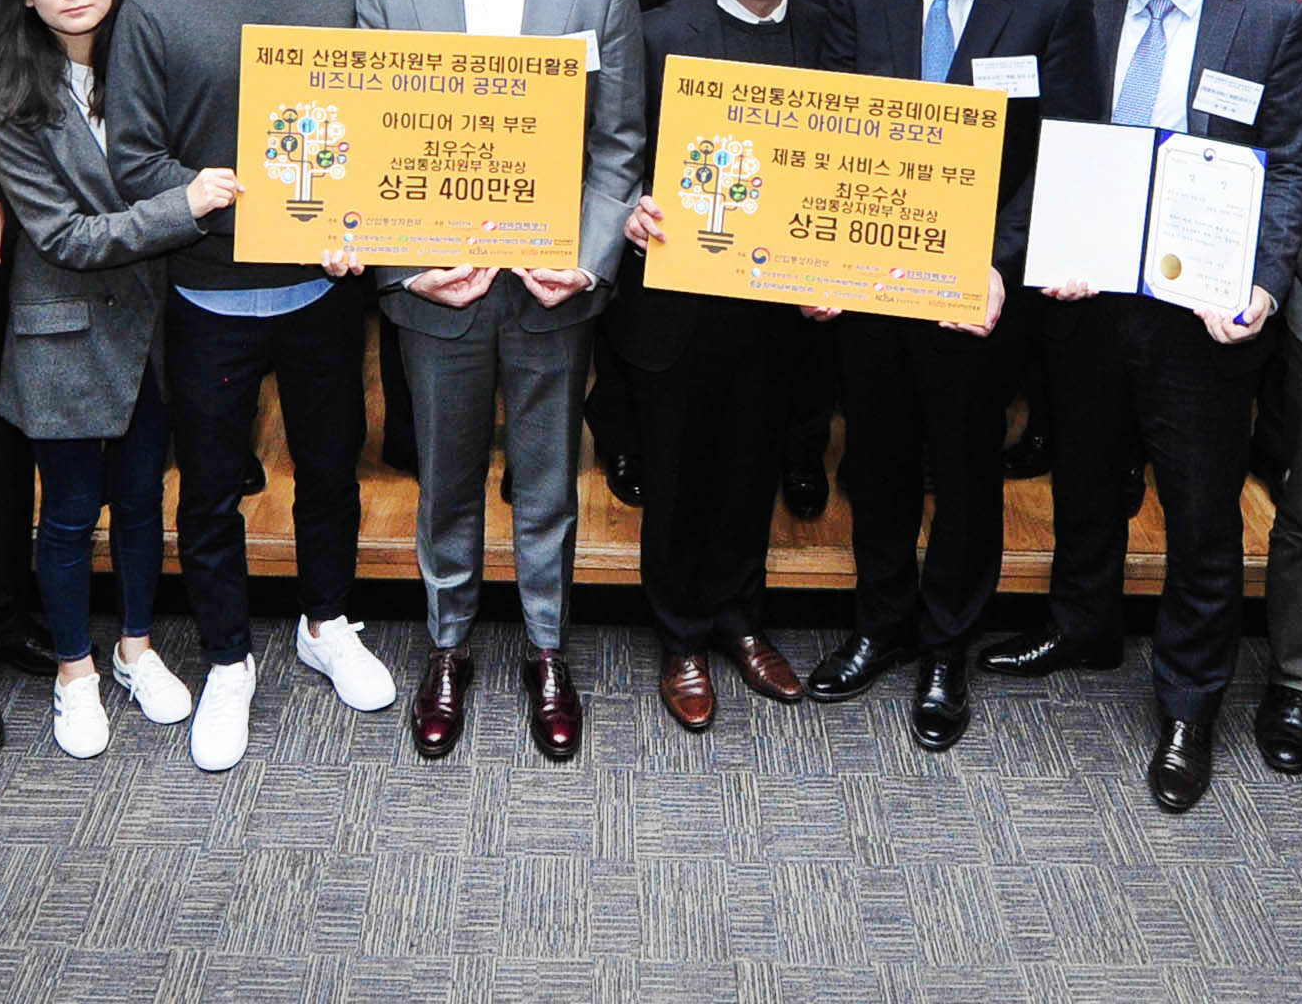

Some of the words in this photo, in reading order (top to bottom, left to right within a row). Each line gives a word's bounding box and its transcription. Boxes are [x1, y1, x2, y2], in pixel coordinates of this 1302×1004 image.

[256, 46, 304, 67] 제4회
[312, 48, 443, 71] 산업통상자원부
[451, 55, 580, 77] 공공데이터활용
[309, 71, 383, 92] 비즈니스
[392, 74, 465, 95] 아이디어
[473, 77, 527, 96] 공모전
[677, 77, 723, 99] 제4회
[731, 84, 860, 114] 산업통상자원부
[869, 99, 998, 128] 공공데이터활용
[382, 112, 453, 132] 아이디어
[463, 114, 495, 133] 기획
[504, 117, 537, 134] 부문
[728, 105, 799, 129] 비즈니스
[808, 113, 881, 138] 아이디어
[888, 122, 943, 145] 공모전
[423, 141, 496, 159] 최우수상
[390, 157, 482, 172] 산업통상자원부
[488, 160, 526, 173] 장관상
[771, 148, 806, 168] 제품
[815, 153, 831, 170] 및
[838, 155, 890, 177] 서비스
[898, 161, 933, 182] 개발
[941, 165, 976, 186] 부문
[378, 175, 427, 201] 상금
[439, 177, 536, 203] 400만원
[835, 182, 908, 206] 최우수상
[802, 197, 893, 219] 산업통상자원부
[899, 206, 938, 223] 장관상
[788, 214, 837, 243] 상금
[849, 221, 947, 254] 800만원
